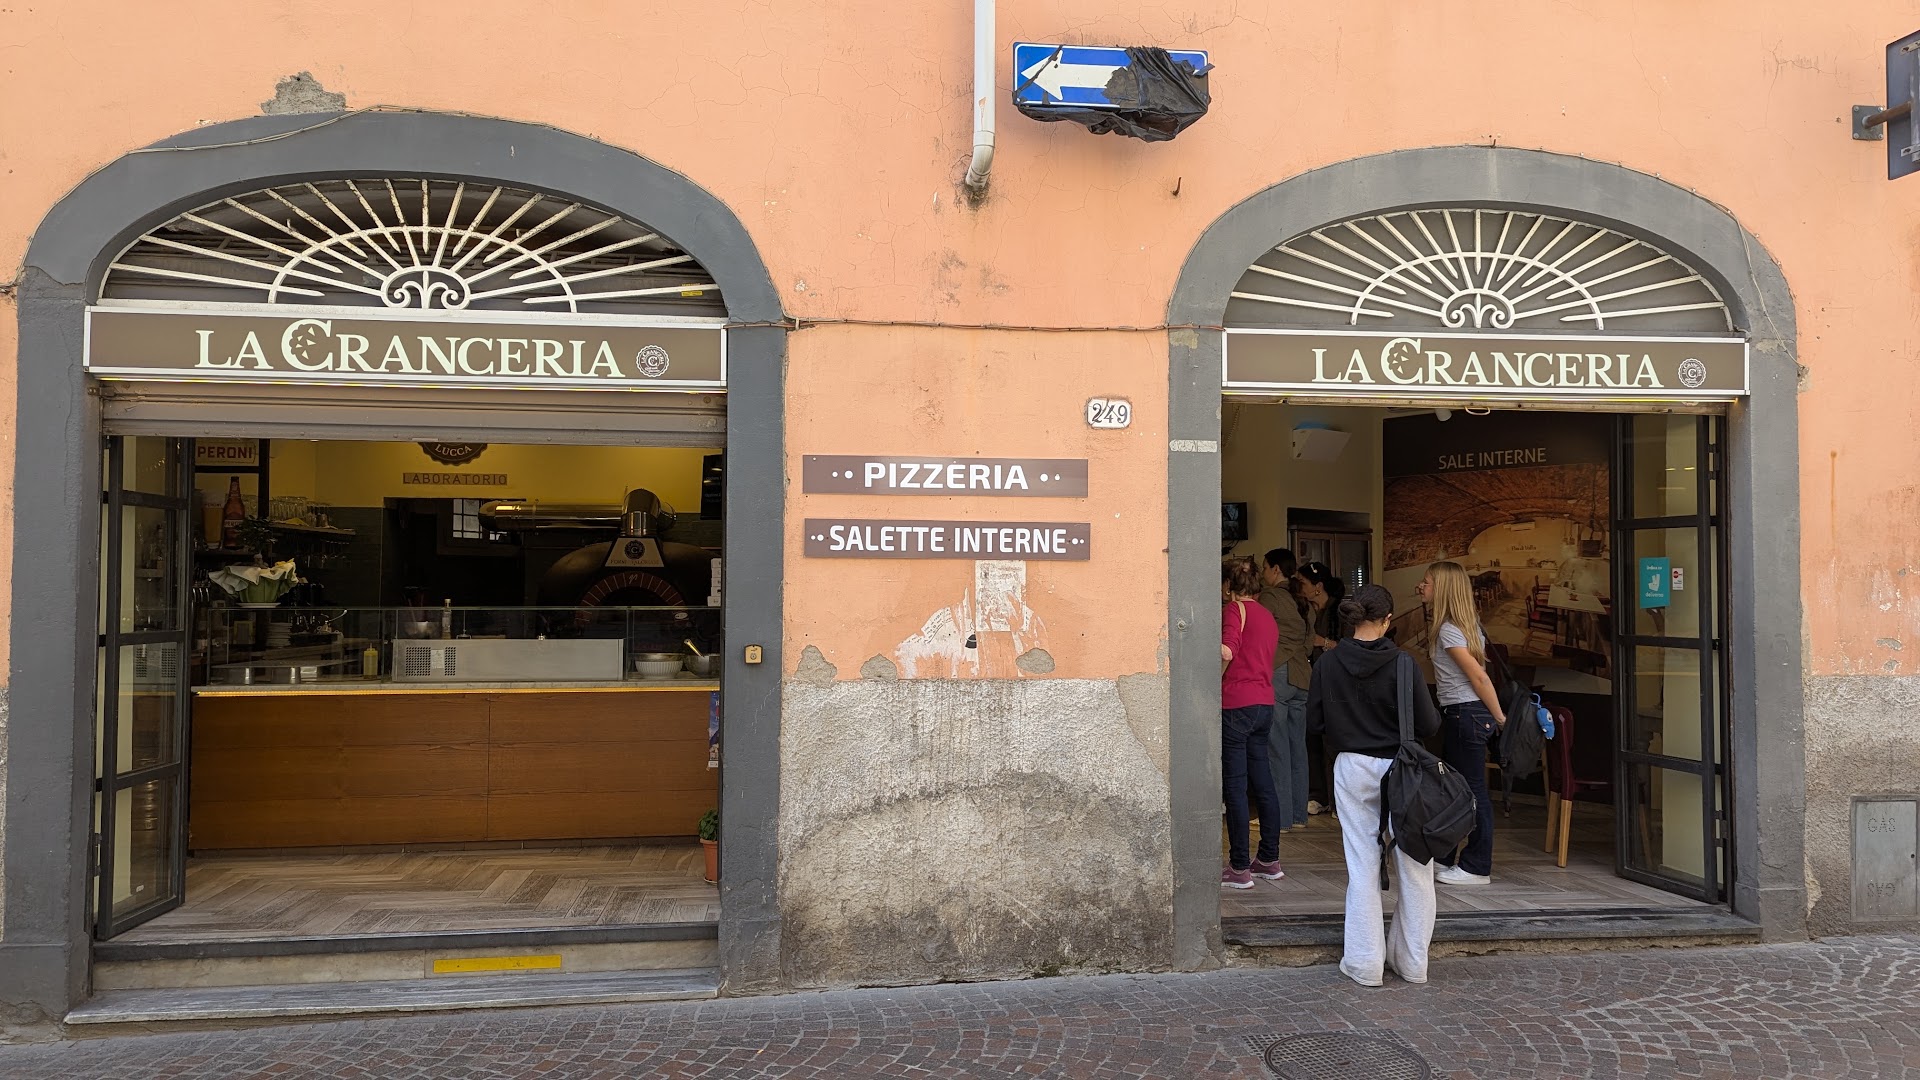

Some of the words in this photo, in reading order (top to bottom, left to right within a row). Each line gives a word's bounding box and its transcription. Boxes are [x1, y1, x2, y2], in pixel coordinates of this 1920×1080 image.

[195, 329, 274, 370] LA
[281, 318, 626, 378] CRANCERIA
[1311, 348, 1376, 384] LA
[1380, 337, 1665, 388] CRANCERIA
[1091, 402, 1129, 424] 249
[197, 446, 252, 458] PERONI
[434, 443, 473, 457] LUCCA
[1438, 452, 1475, 471] SALE
[1478, 446, 1547, 468] INTERNE
[403, 473, 508, 485] LABORATORIO
[864, 462, 1029, 490] PIZZERIA
[829, 525, 945, 552] SALETTE
[954, 527, 1067, 554] INTERNE
[1867, 817, 1896, 833] GAS
